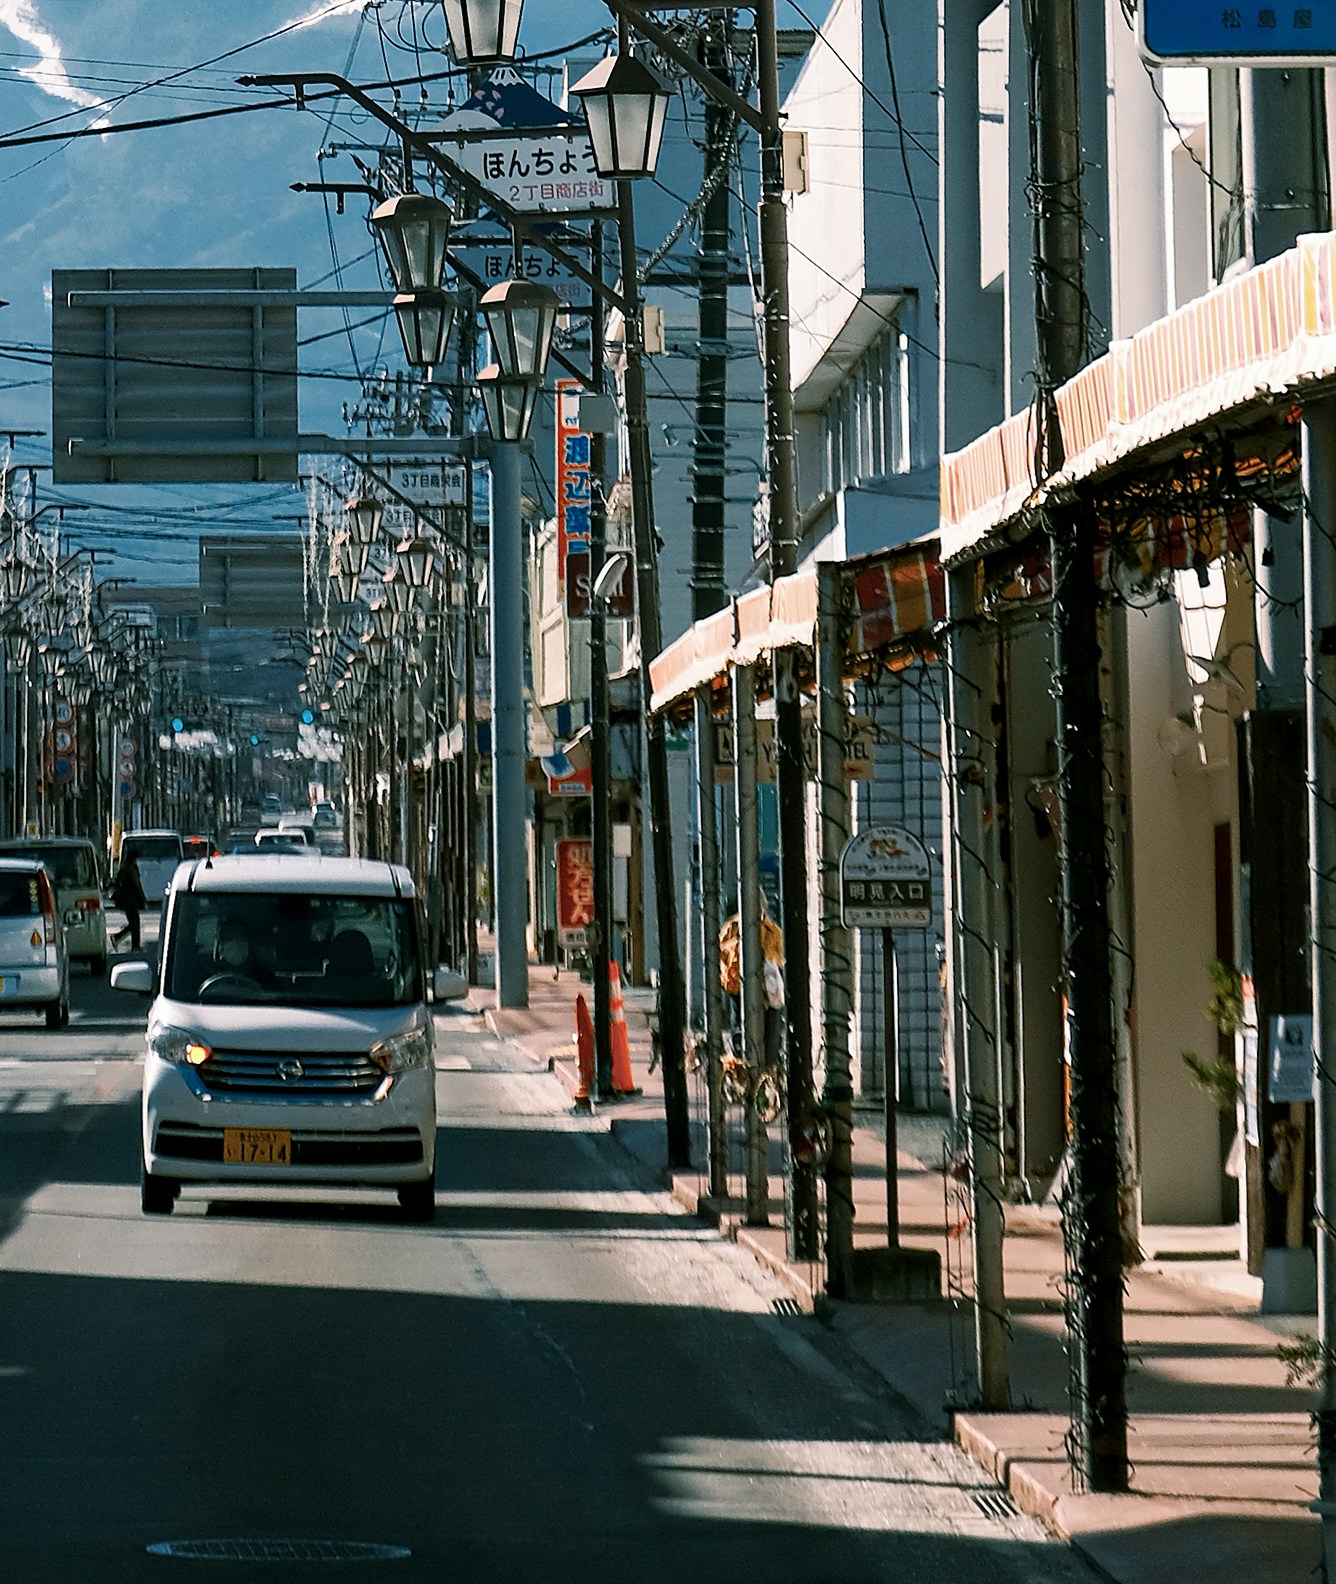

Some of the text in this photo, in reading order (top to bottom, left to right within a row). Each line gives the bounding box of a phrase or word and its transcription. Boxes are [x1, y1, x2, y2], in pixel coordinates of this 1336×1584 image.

[1221, 8, 1313, 29] 松島屋
[509, 182, 604, 202] 2丁目商店街
[849, 882, 924, 901] 明見入口
